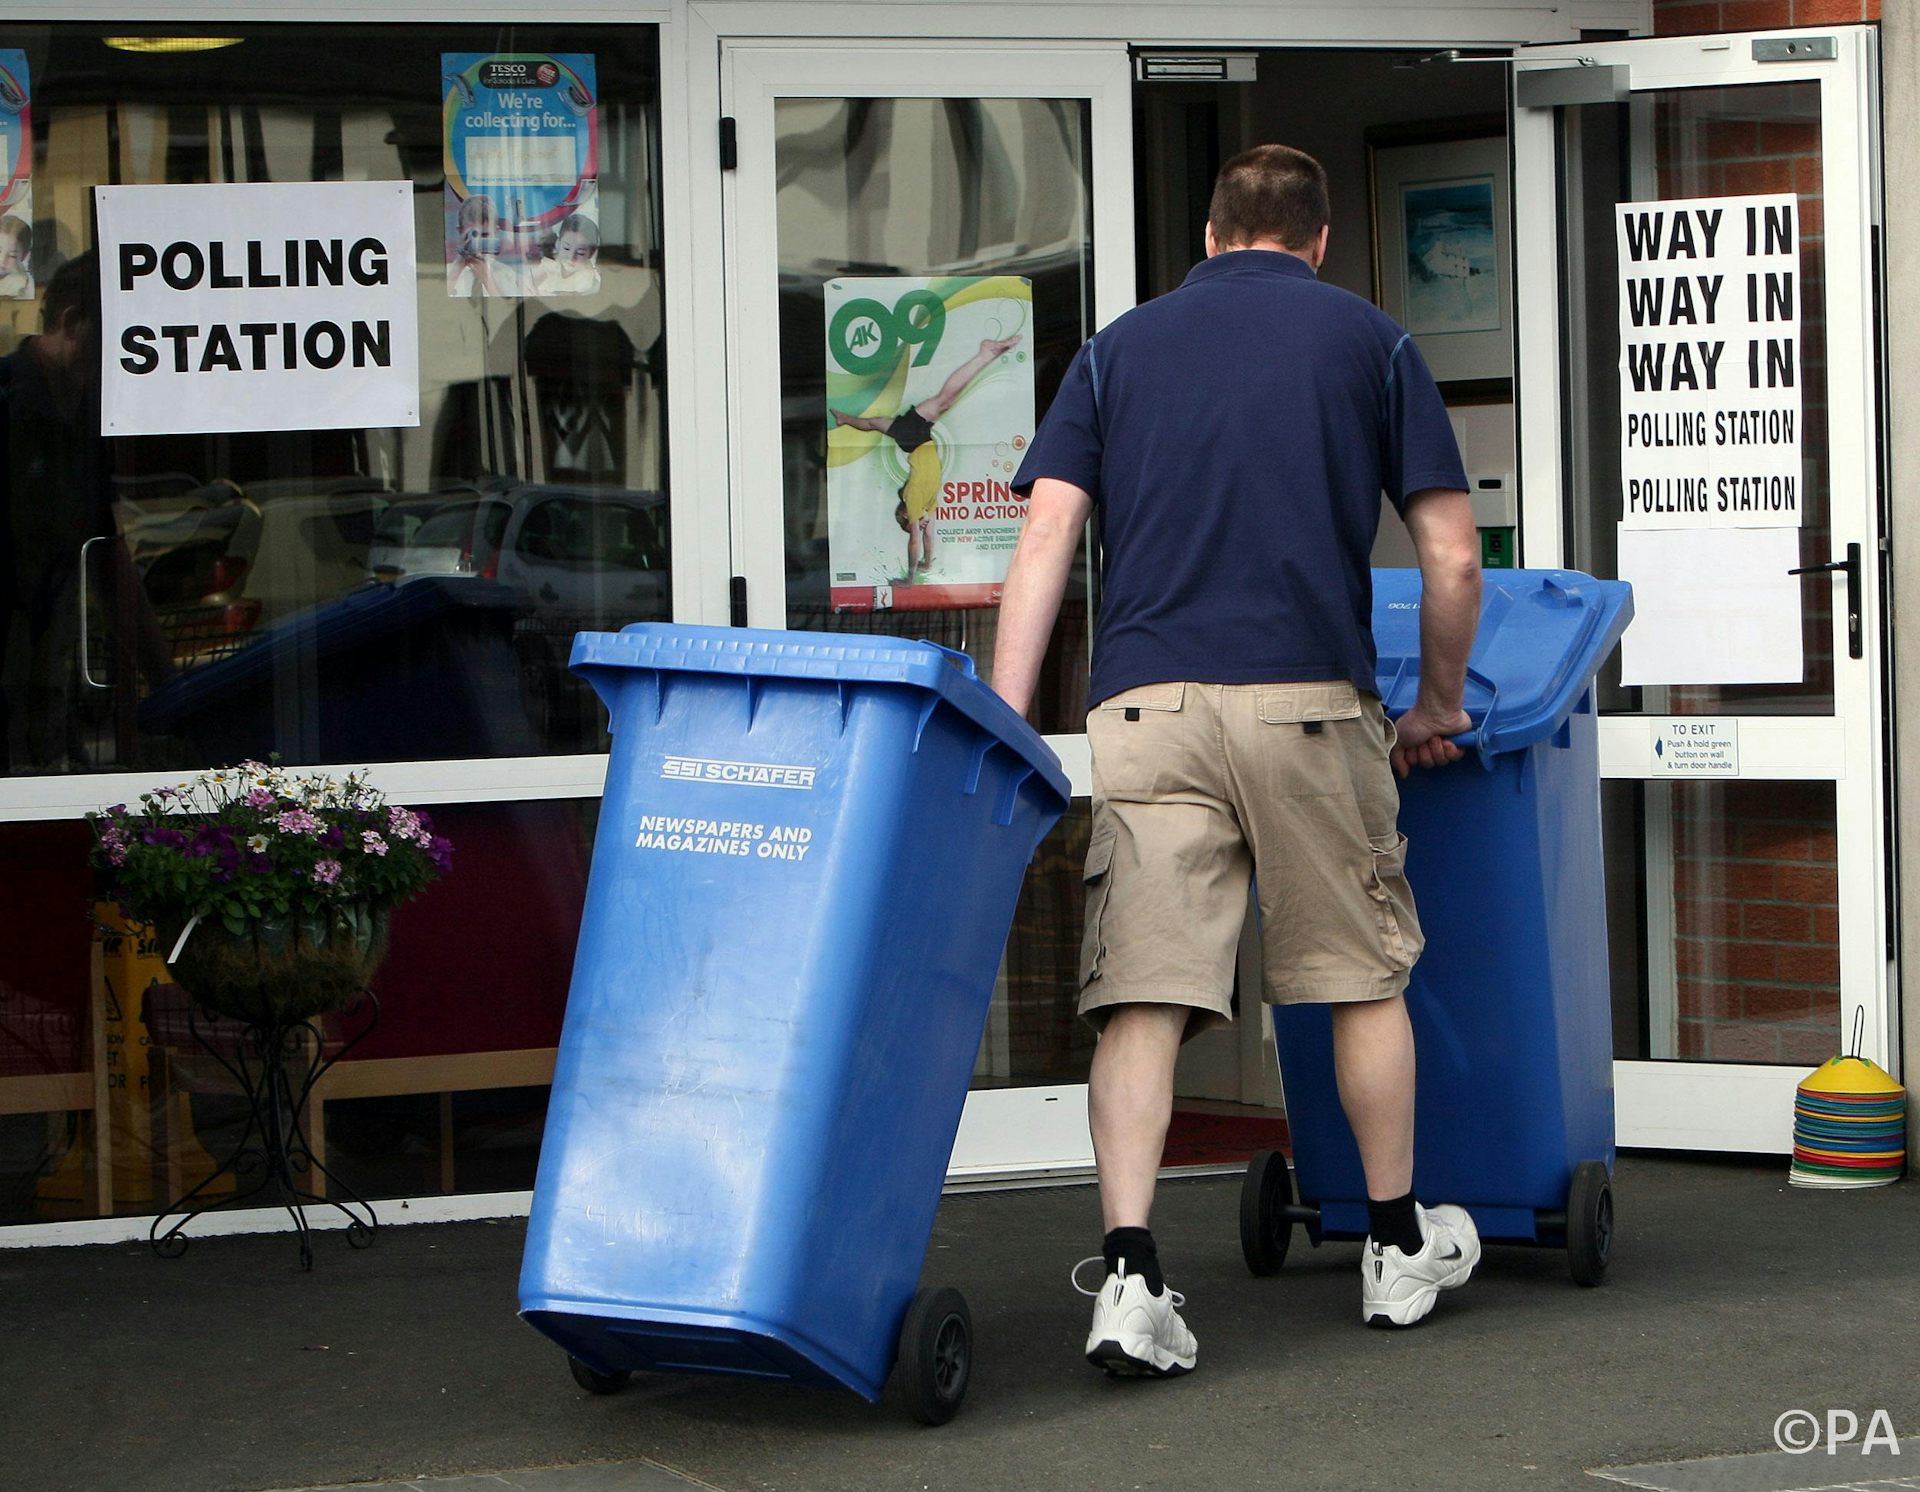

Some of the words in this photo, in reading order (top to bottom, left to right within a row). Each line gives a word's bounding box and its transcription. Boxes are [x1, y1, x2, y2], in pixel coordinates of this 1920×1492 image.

[490, 64, 527, 73] TESCO
[498, 92, 543, 108] We're
[465, 112, 540, 131] collecting
[543, 112, 576, 127] for...
[1625, 208, 1724, 262] WAY
[1746, 205, 1794, 258] IN
[118, 238, 389, 291] POLLING
[1627, 275, 1724, 327] WAY
[1746, 272, 1794, 323] IN
[119, 320, 391, 375] STATION
[1627, 341, 1724, 392] WAY
[1746, 338, 1794, 388] IN
[1628, 412, 1706, 448] POLLING
[1715, 409, 1794, 446] STATION
[1629, 478, 1708, 513] POLLING
[1717, 476, 1795, 512] STATION
[936, 507, 969, 520] INTO
[1672, 724, 1687, 736] TO
[1691, 724, 1716, 736] EXIT
[1667, 740, 1685, 748] Push
[1686, 740, 1692, 748] &
[1694, 740, 1709, 748] hold
[1711, 741, 1732, 750] green
[1675, 751, 1698, 759] button
[1710, 750, 1724, 759] wall
[662, 760, 702, 777] SSI
[1667, 761, 1673, 769] &
[1690, 761, 1706, 769] door
[1708, 761, 1732, 769] handle
[640, 815, 764, 840] NEWSPAPERS
[768, 826, 812, 844] AND
[635, 833, 750, 857] MAGAZINES
[757, 842, 810, 862] ONLY
